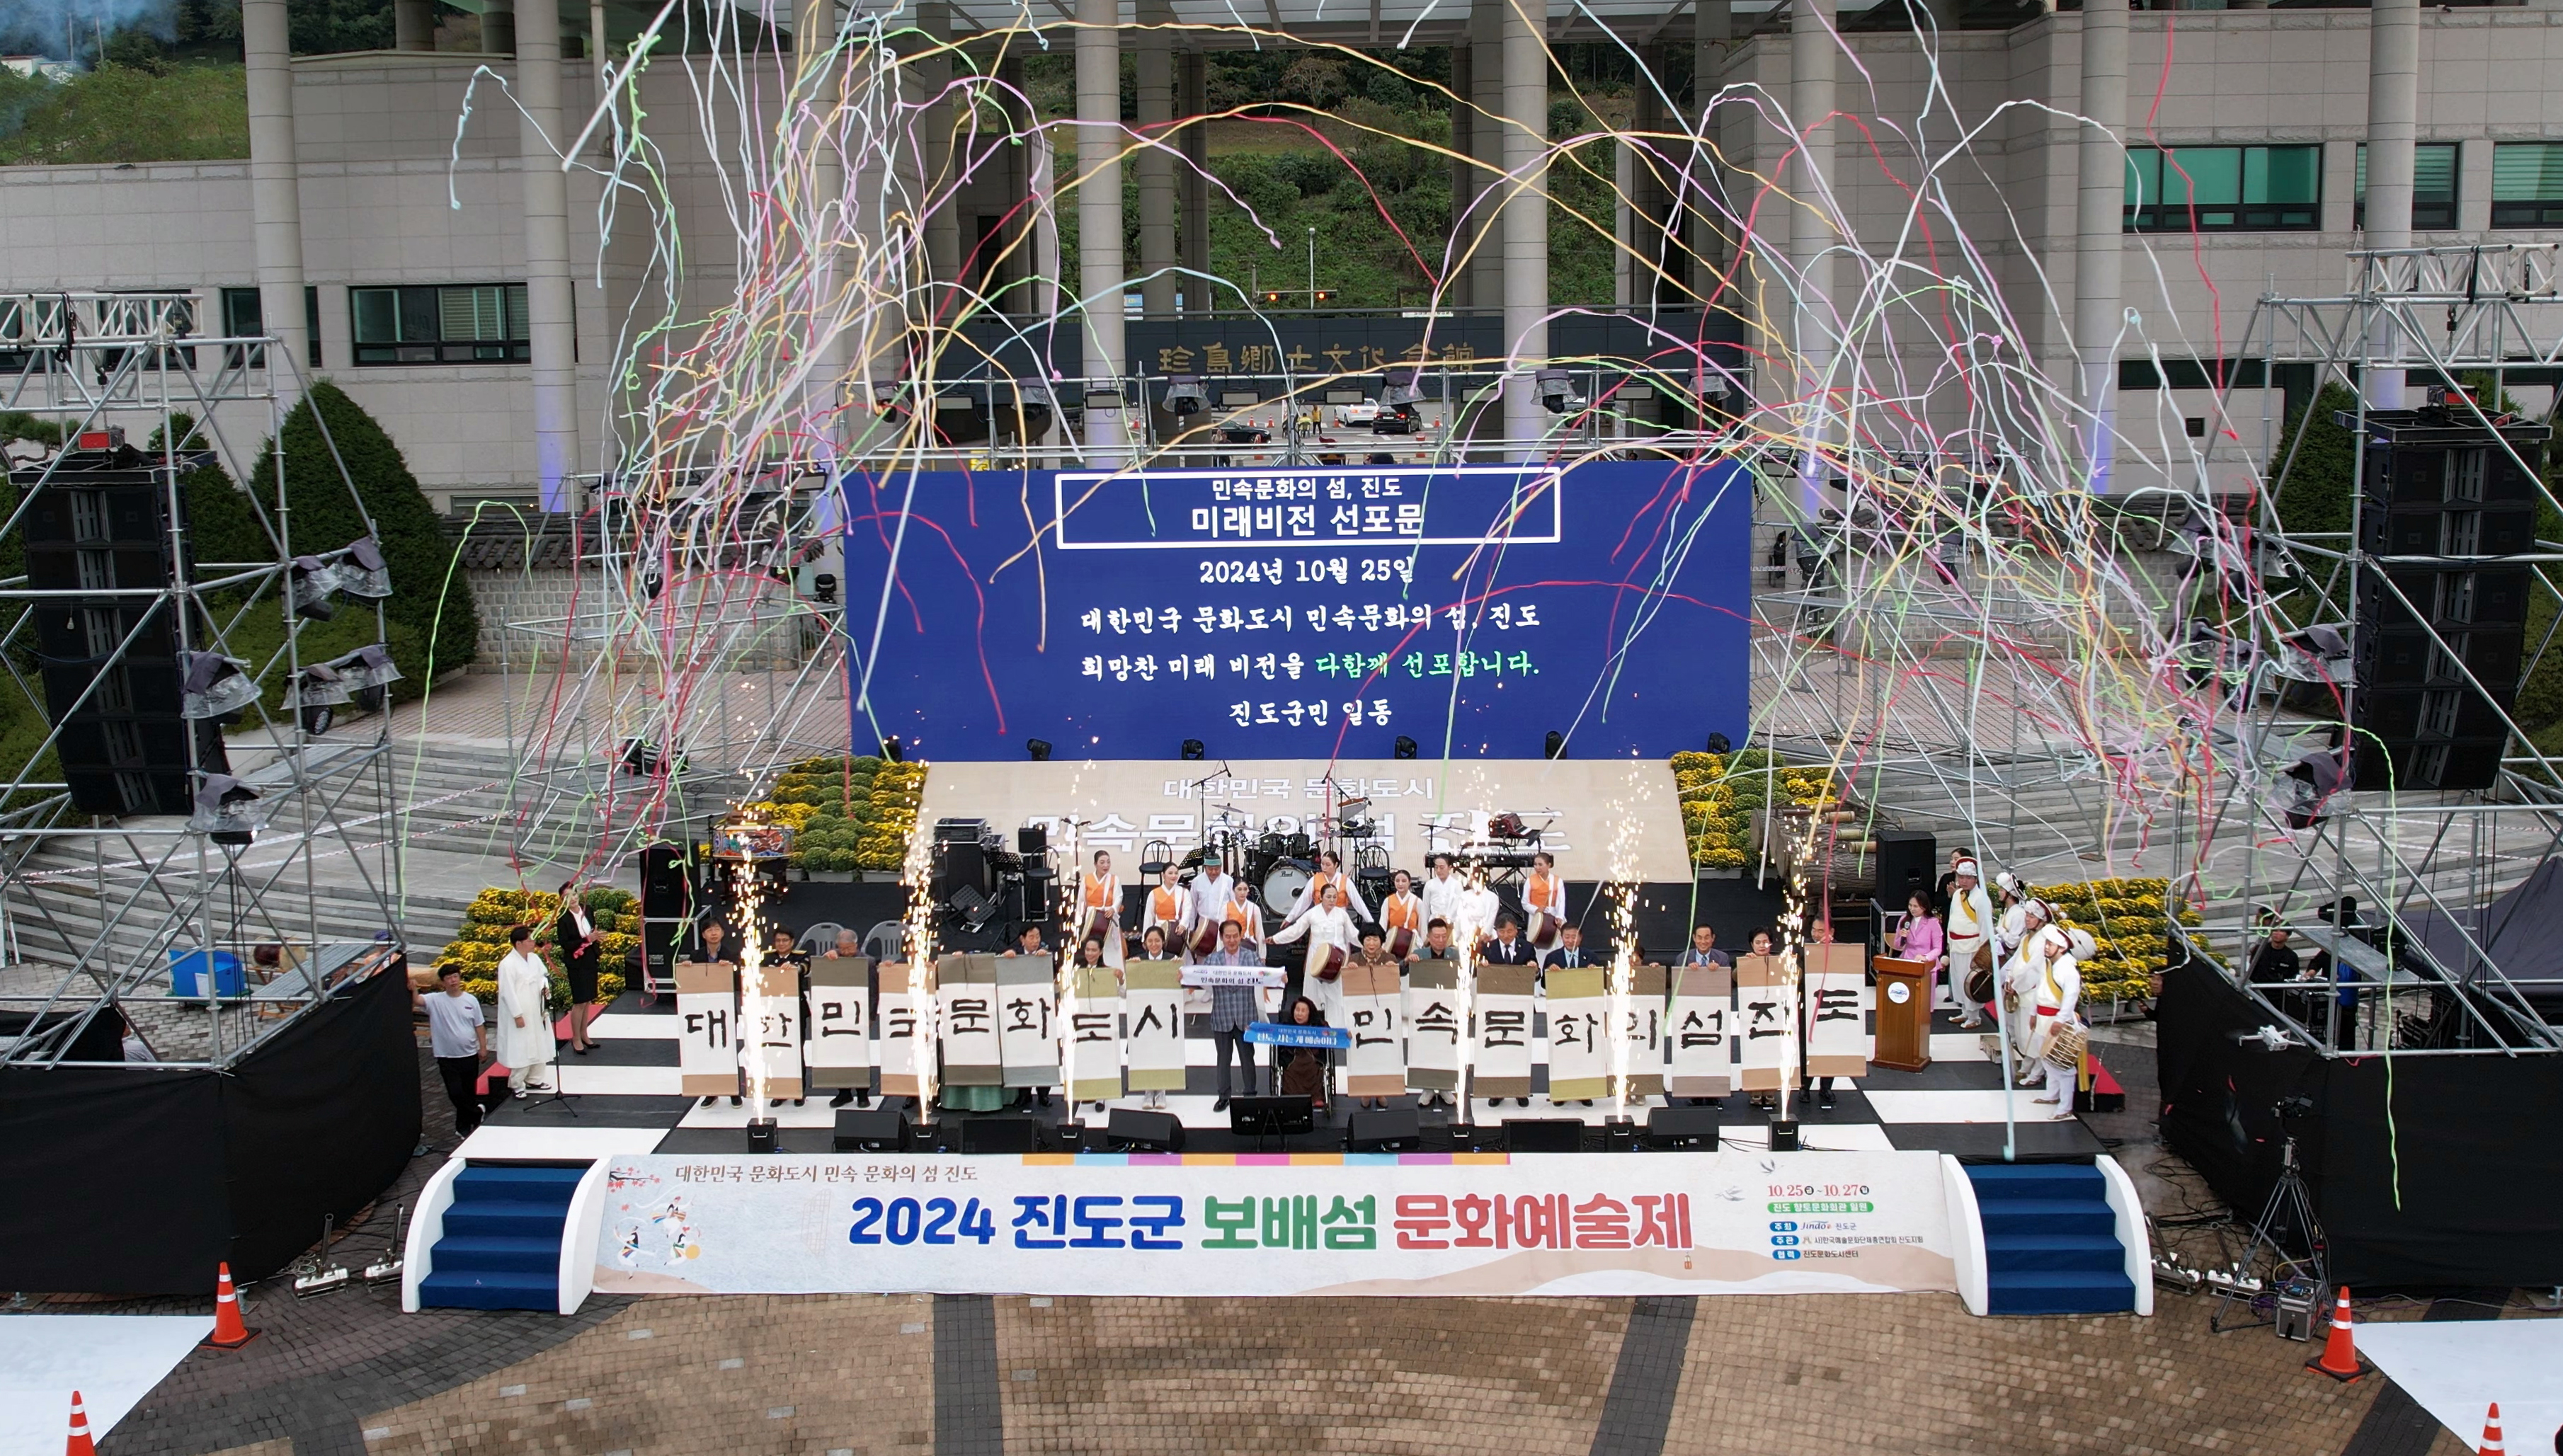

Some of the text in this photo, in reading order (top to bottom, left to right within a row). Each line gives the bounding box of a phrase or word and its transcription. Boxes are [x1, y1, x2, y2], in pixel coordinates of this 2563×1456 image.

[1212, 476, 1403, 500] 민속문화의 섬, 진도
[1192, 503, 1424, 538] 미래비전 선포문
[1199, 556, 1415, 585] 2024년 10월 25일
[1080, 607, 1182, 634] 대한민국
[1192, 605, 1293, 633] 문화도시
[1306, 604, 1432, 632] 민속문화의
[1489, 603, 1540, 628] 진도
[1081, 650, 1540, 682] 희망찬 미래 비전을 다함께 선포합니다.
[1228, 698, 1392, 727] 진도군민 일동
[1163, 777, 1434, 800] 대한민국 문화도시
[685, 1009, 727, 1050] 대
[821, 1000, 861, 1038] 민
[951, 998, 991, 1036] 문
[1006, 997, 1052, 1040] 화
[1133, 1002, 1178, 1039] 시
[1352, 1007, 1394, 1050] 민
[1484, 1010, 1526, 1049] 문
[1554, 1012, 1599, 1053] 화
[1680, 1009, 1723, 1050] 섬
[675, 1164, 978, 1183] 대한민국 문화도시 민속 문화의 섬 진도
[849, 1192, 1693, 1251] 2024 진도군 보배섬 문화예술제
[1773, 1203, 1791, 1213] 진도
[1835, 1223, 1858, 1232] 진도군
[1803, 1250, 1859, 1259] 진도문화도시센터
